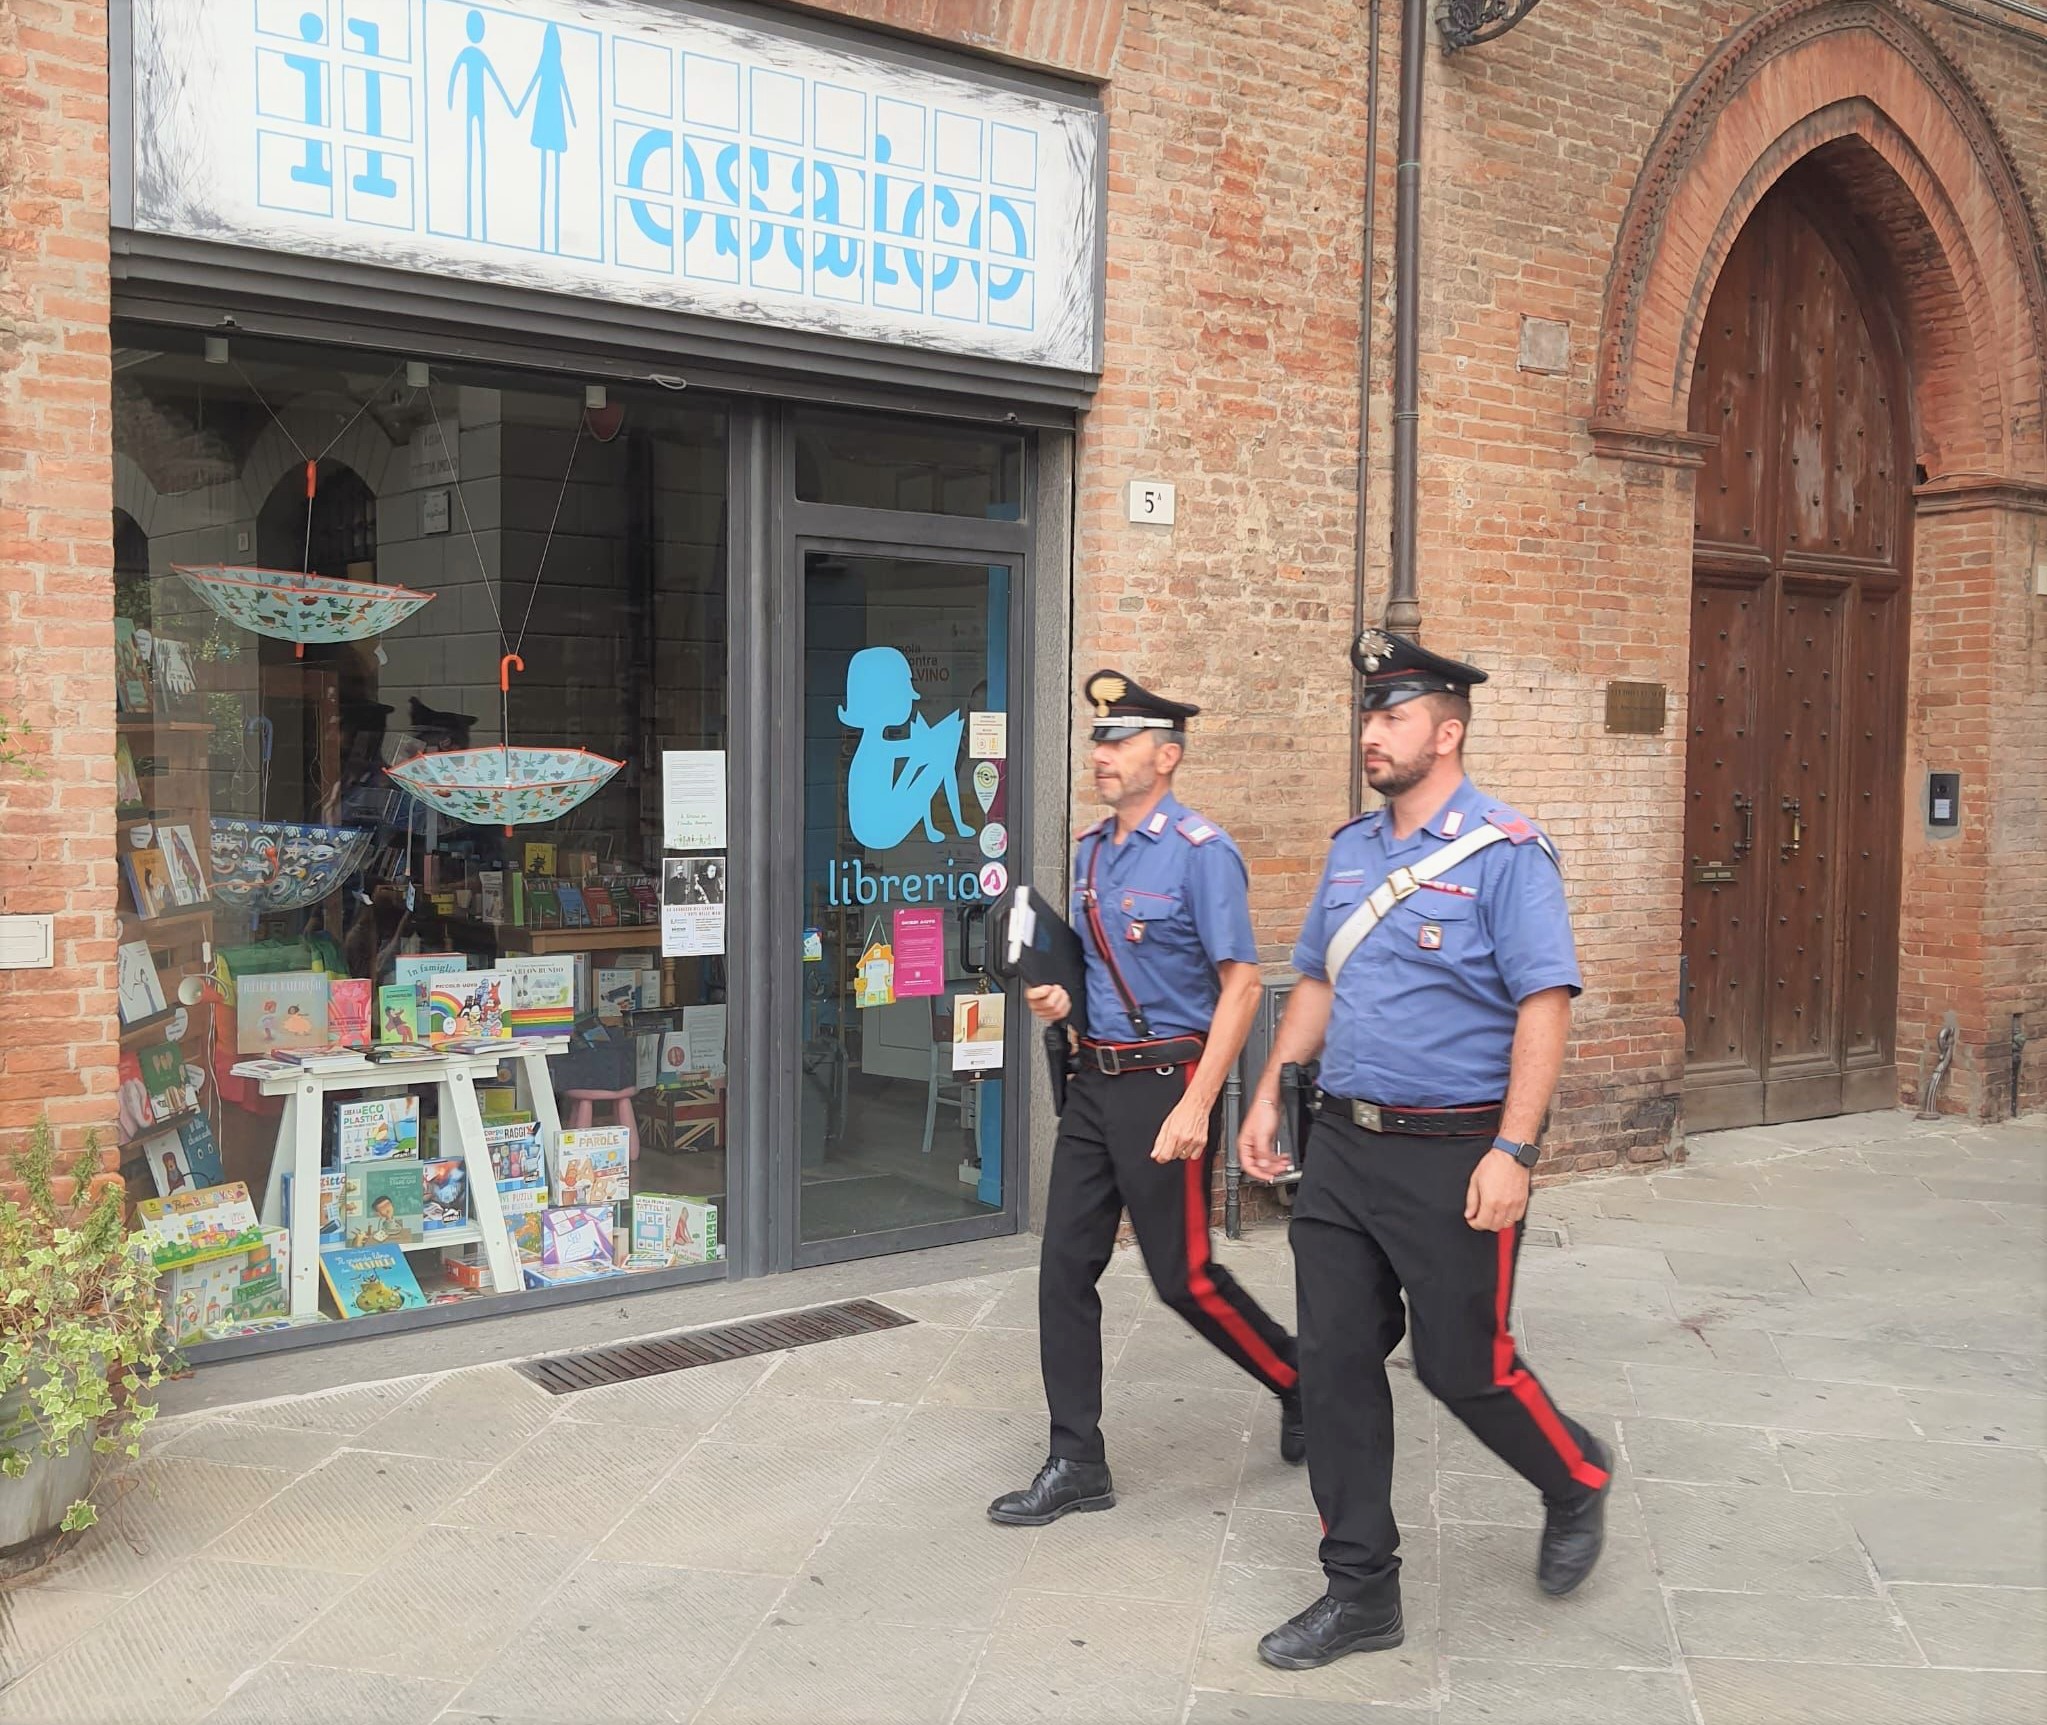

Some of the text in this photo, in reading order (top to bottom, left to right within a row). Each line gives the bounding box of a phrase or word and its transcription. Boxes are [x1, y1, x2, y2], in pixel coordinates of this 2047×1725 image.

[283, 11, 397, 199] il
[828, 858, 982, 906] libreria
[362, 1103, 384, 1115] ECO
[343, 1114, 385, 1125] PLASTICA
[504, 1126, 526, 1139] RAGGI
[578, 1132, 620, 1148] PAROLE
